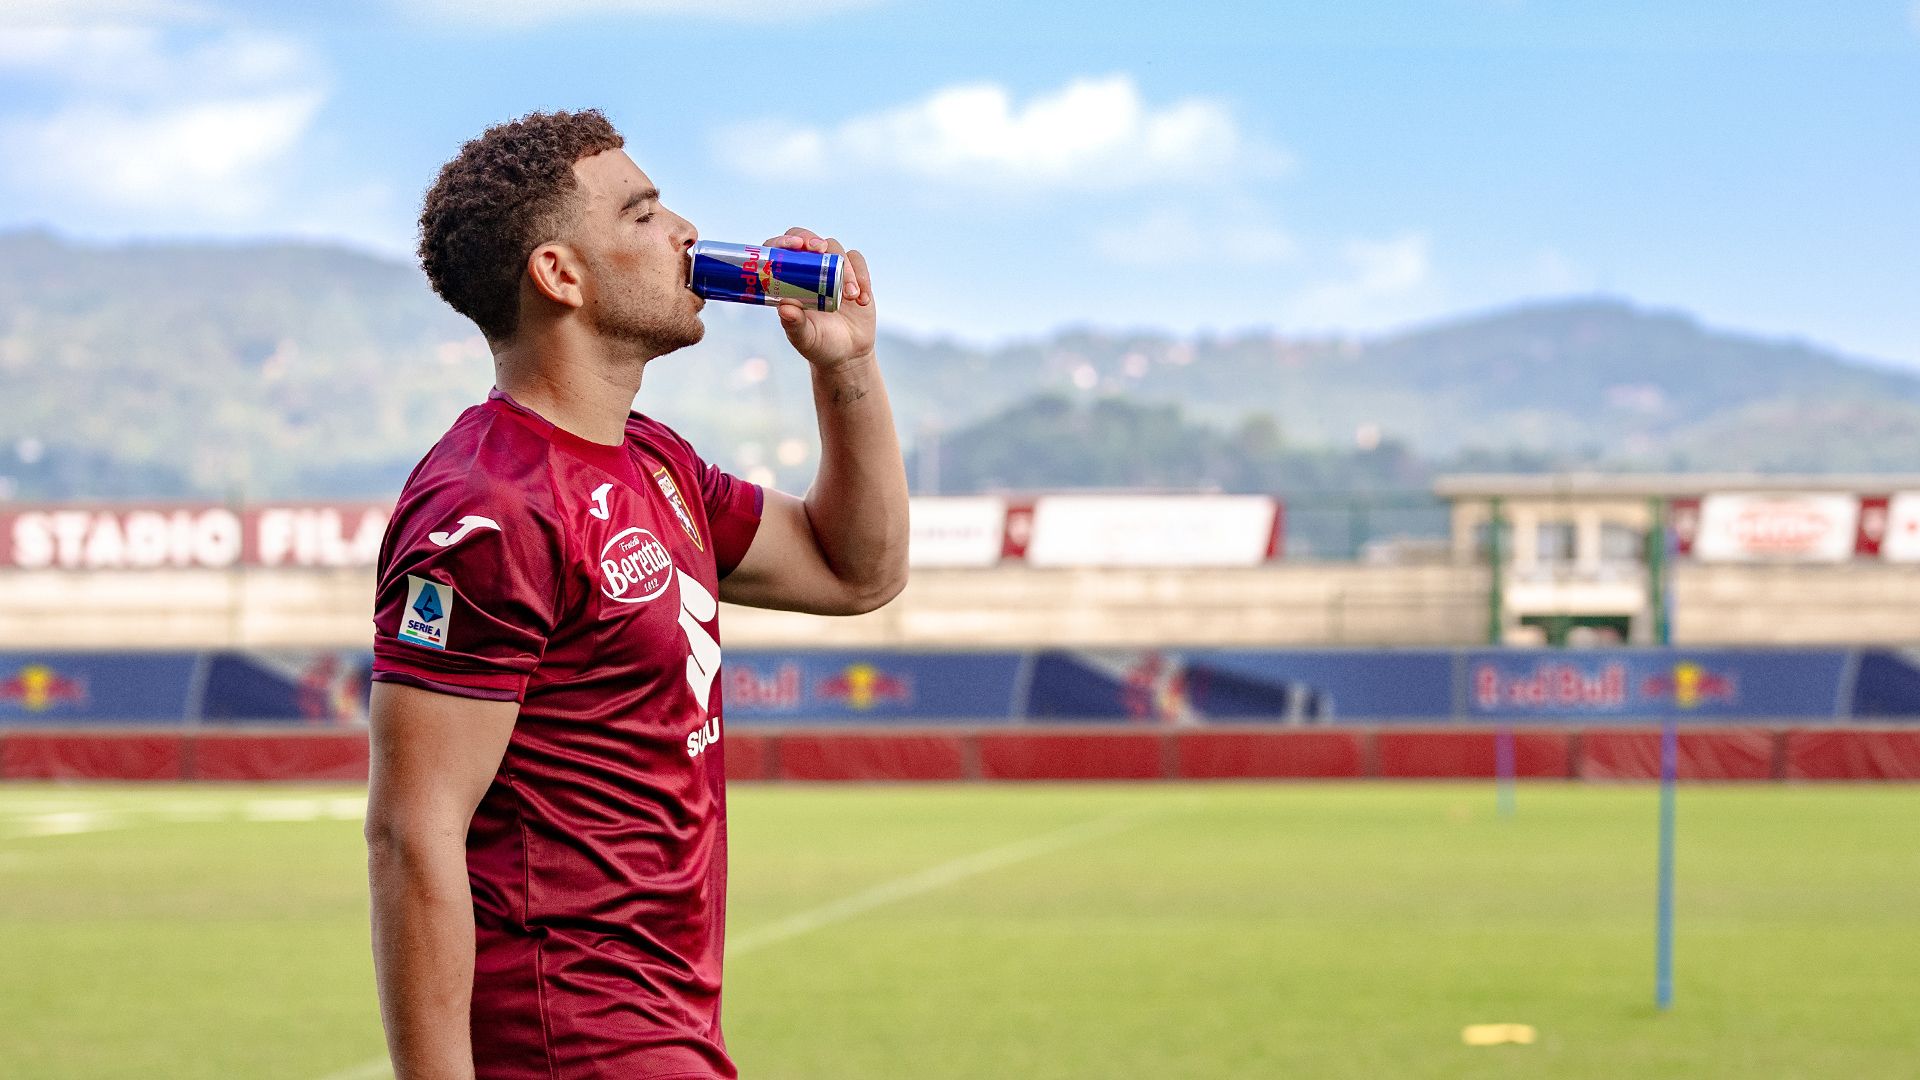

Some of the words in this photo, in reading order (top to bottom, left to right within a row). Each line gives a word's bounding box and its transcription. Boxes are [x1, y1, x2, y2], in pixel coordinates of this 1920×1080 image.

[742, 246, 761, 273] Bull
[12, 509, 242, 567] STADIO
[601, 539, 671, 598] Beretta
[407, 619, 434, 635] SERIE
[434, 627, 441, 637] A
[687, 716, 720, 758] SUU
